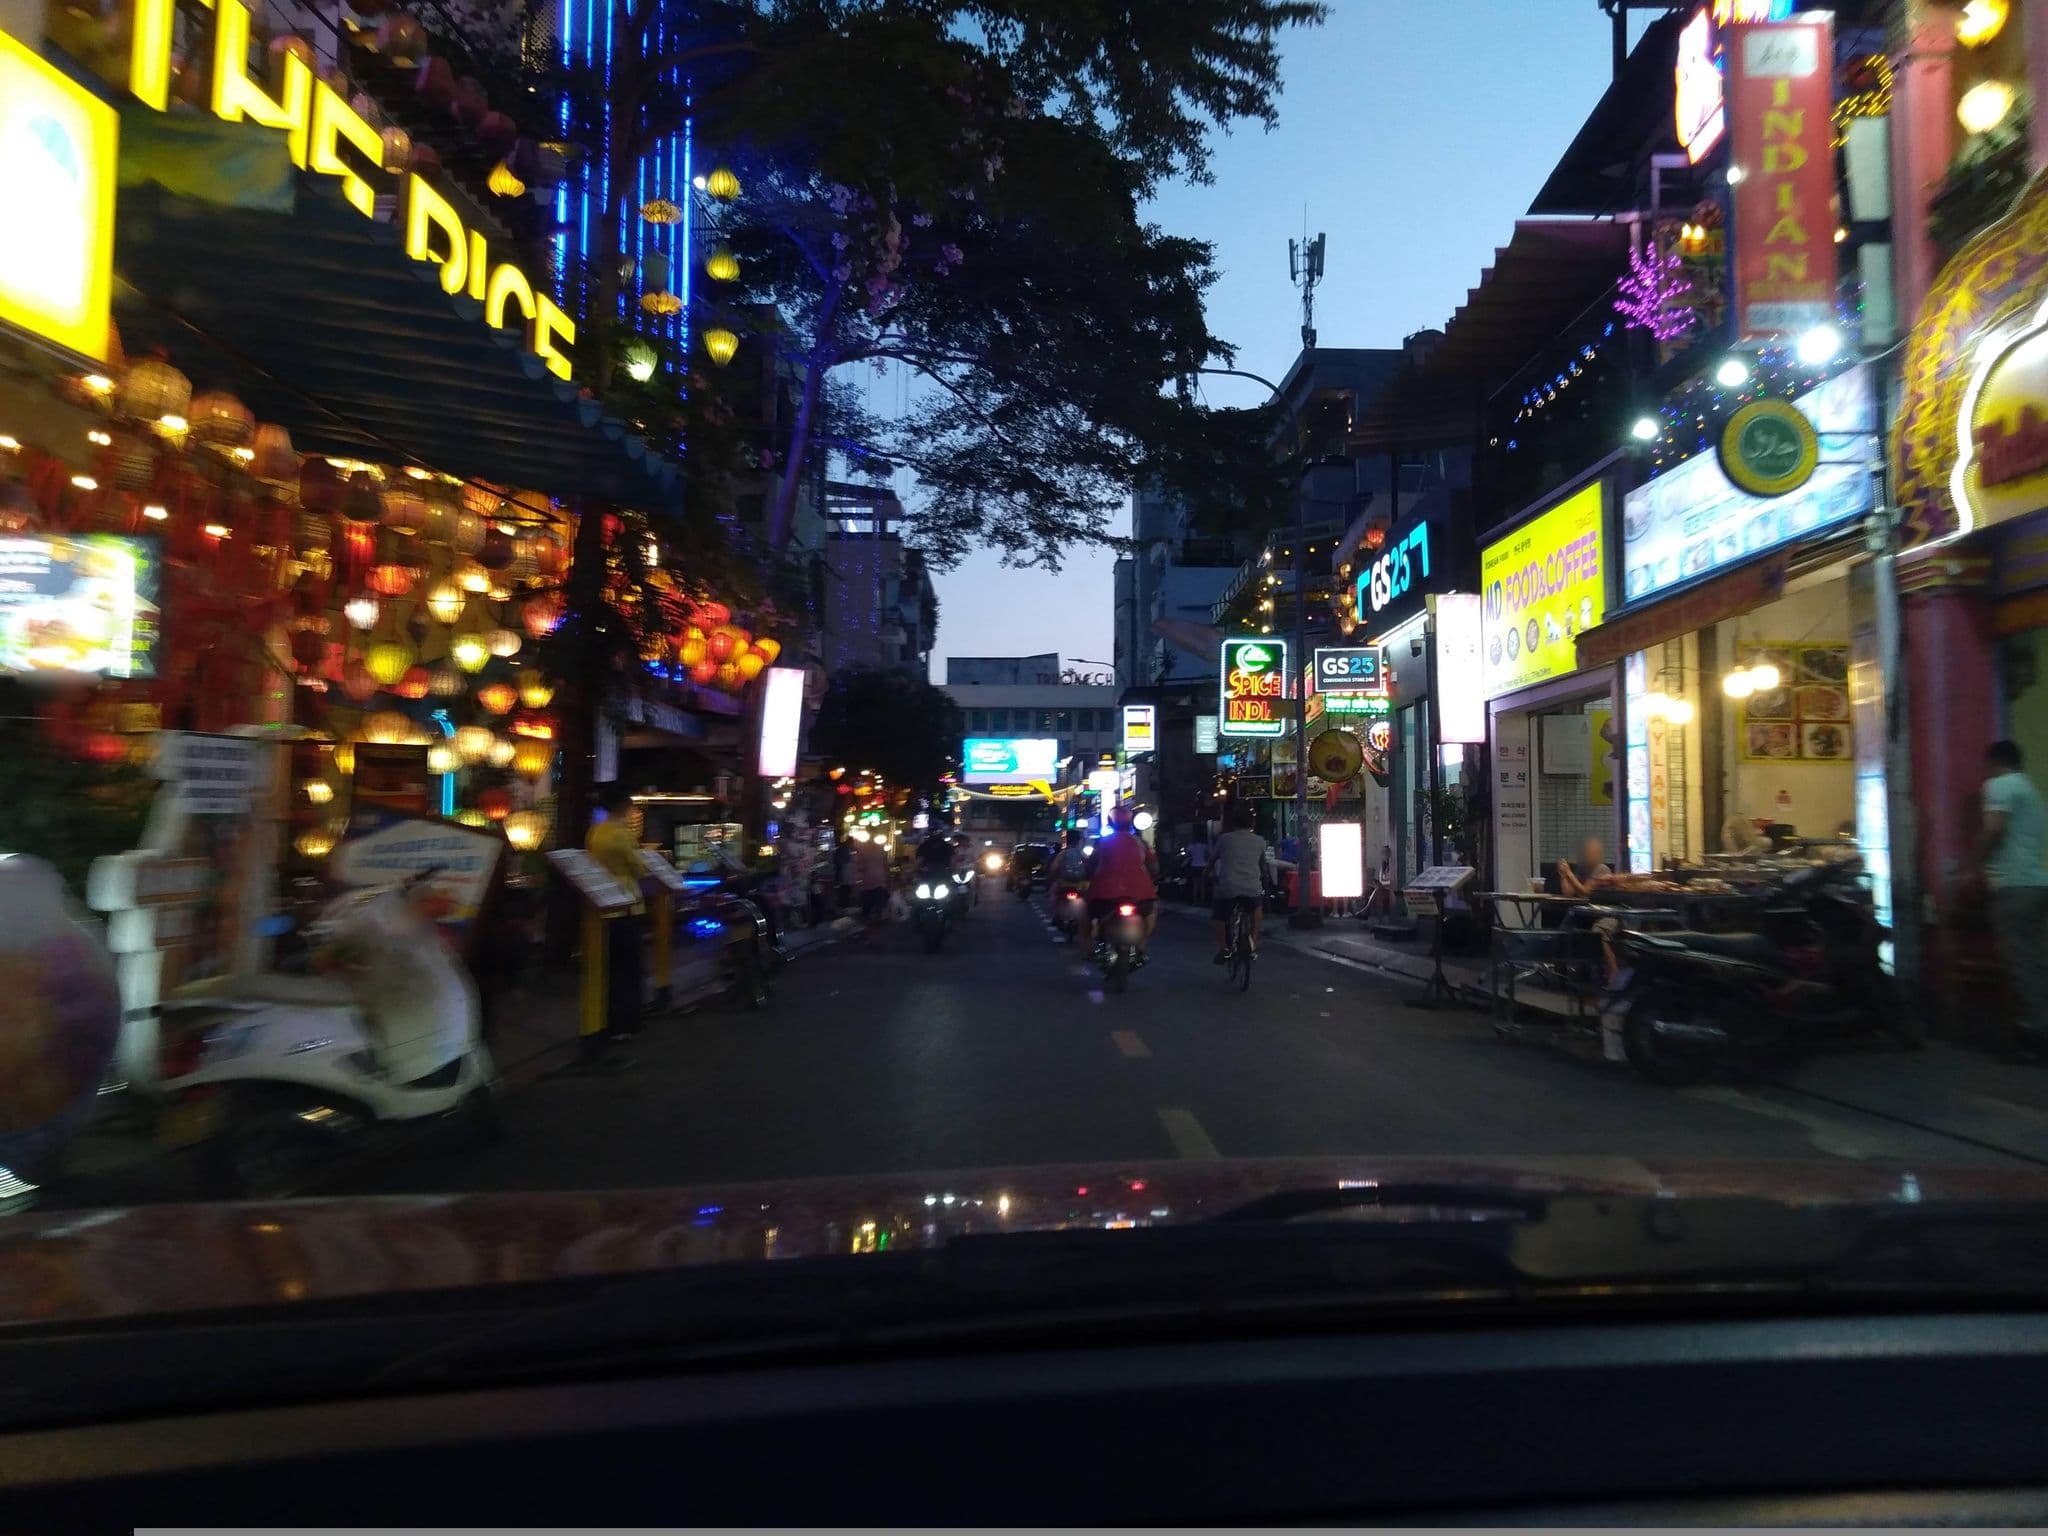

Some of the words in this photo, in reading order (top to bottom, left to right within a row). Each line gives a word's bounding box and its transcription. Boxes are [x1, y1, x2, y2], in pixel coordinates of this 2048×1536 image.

[1762, 79, 1808, 283] INDIAN
[407, 174, 575, 381] DICE
[1371, 538, 1410, 612] GS25
[1486, 580, 1502, 622] MD
[1229, 669, 1281, 697] SPICE
[1322, 657, 1374, 675] GS25
